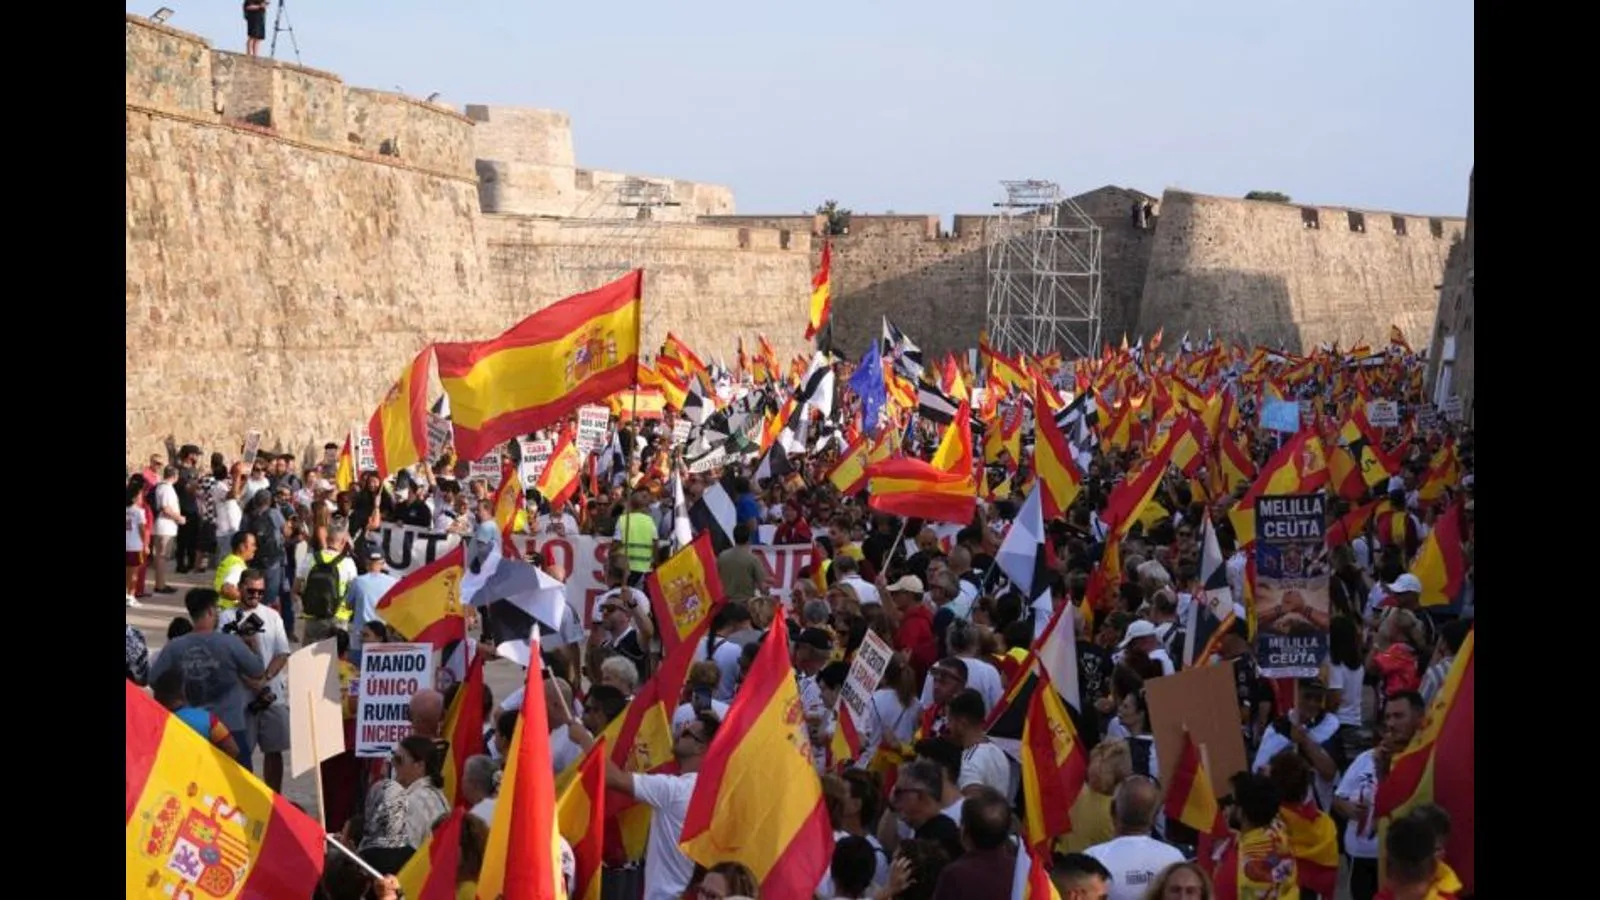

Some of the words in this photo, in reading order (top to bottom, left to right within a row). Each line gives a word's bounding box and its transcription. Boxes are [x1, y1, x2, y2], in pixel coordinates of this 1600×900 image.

[1260, 498, 1323, 516] MELILLA
[1264, 520, 1320, 537] CEUTA
[1268, 637, 1318, 649] MELILLA
[366, 654, 426, 672] MANDO
[1269, 653, 1316, 664] CEUTA
[367, 675, 418, 695] ÚNICO
[364, 703, 411, 720] RUMB
[361, 725, 413, 742] INCIERT
